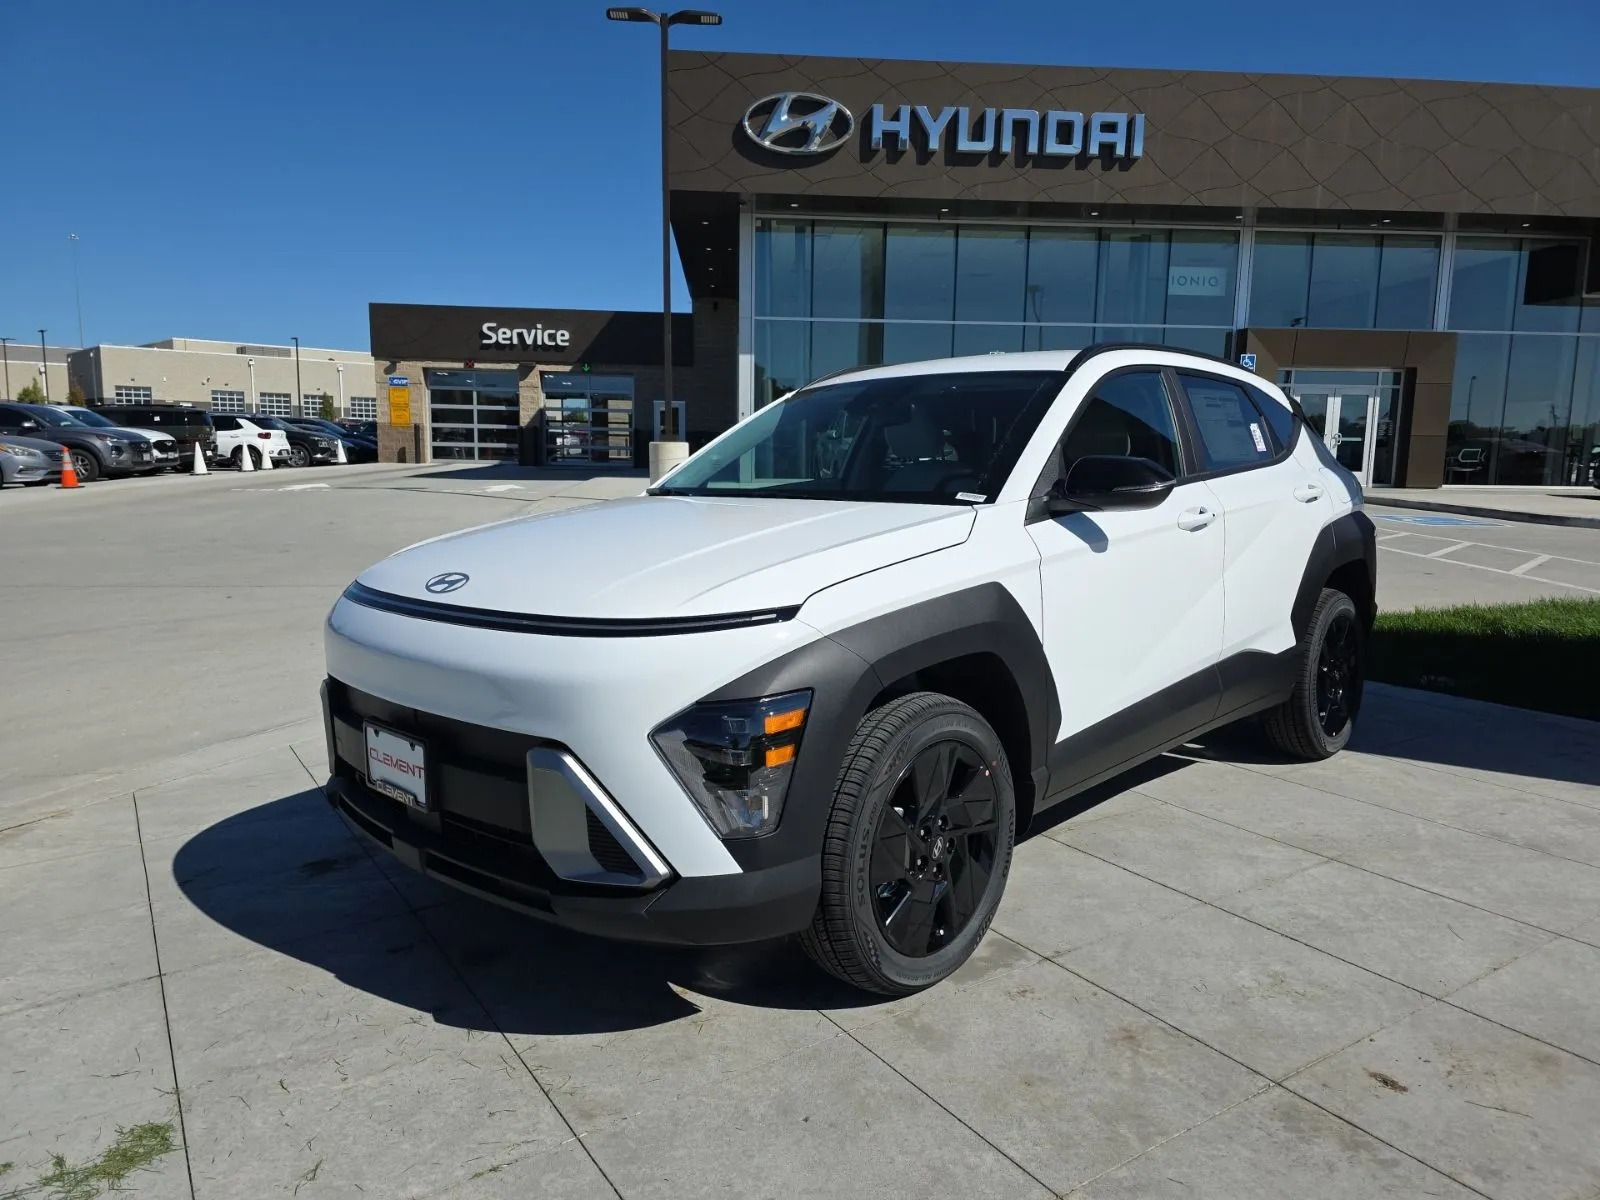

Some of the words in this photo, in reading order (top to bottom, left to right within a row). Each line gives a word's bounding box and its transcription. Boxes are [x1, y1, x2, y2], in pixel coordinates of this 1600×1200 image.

[871, 104, 1145, 158] HYUNDAI
[1172, 275, 1219, 287] IONIQ
[482, 322, 570, 346] Service
[370, 748, 424, 779] CLEMENT
[376, 781, 414, 806] CLEMENT
